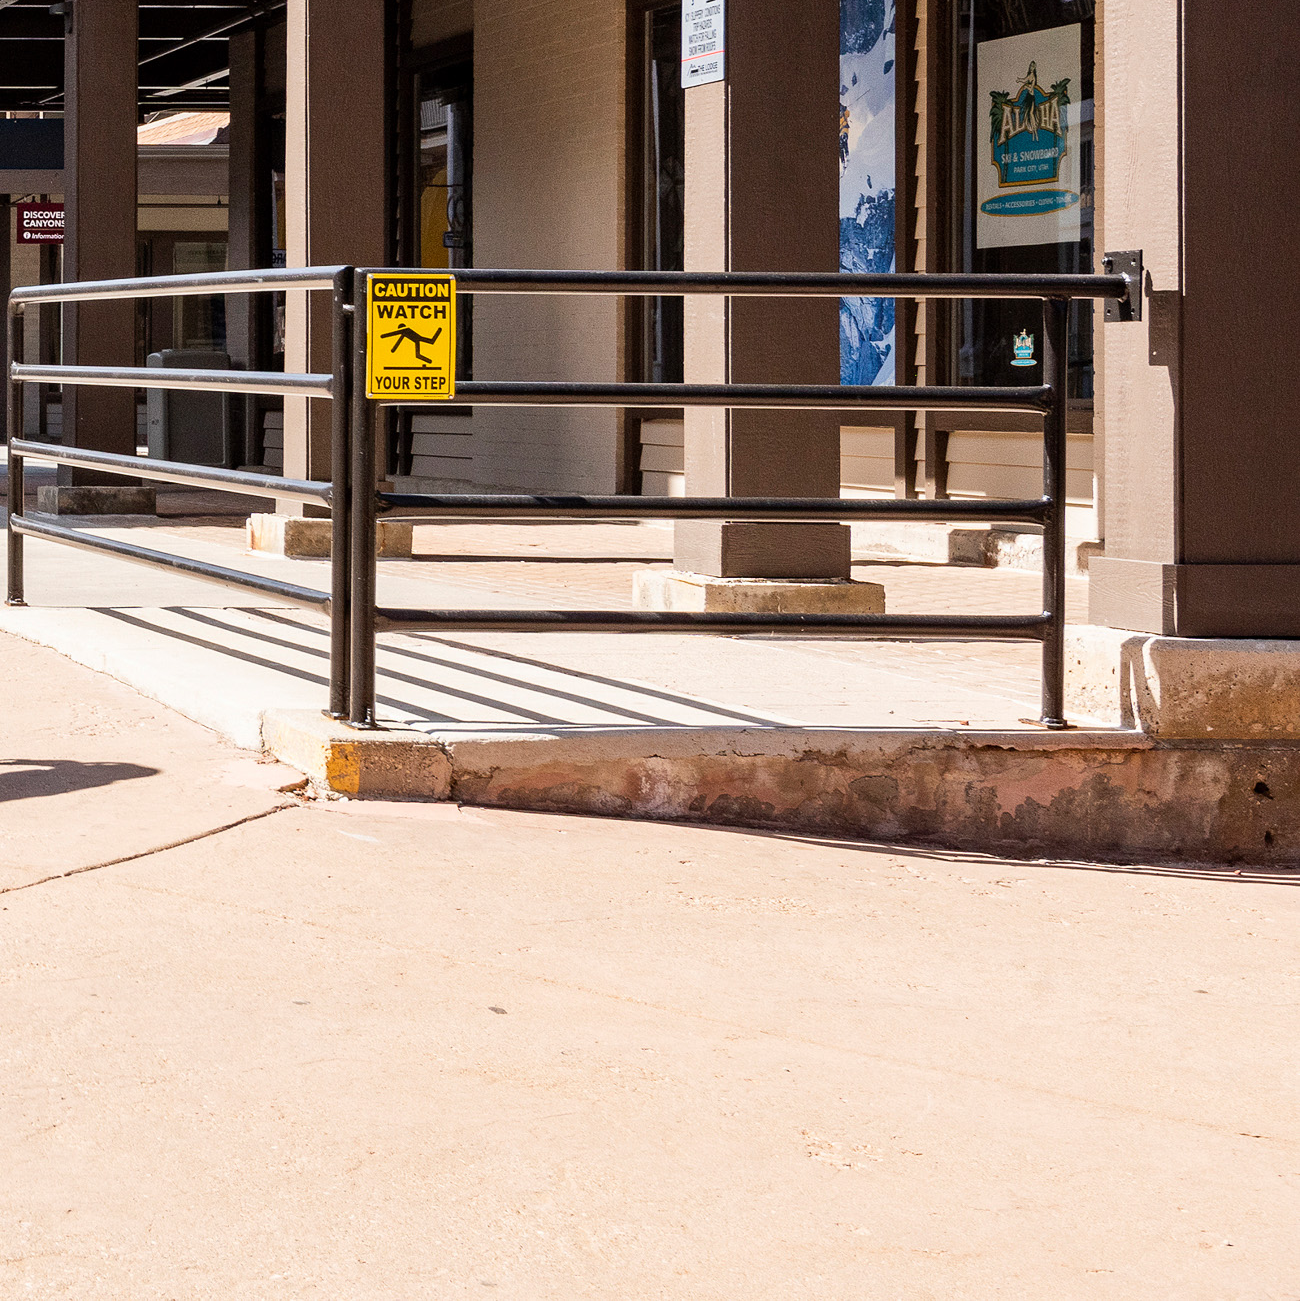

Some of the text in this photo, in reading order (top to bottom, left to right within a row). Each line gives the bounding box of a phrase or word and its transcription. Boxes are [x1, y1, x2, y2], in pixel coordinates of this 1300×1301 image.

[1020, 147, 1059, 162] SNOWBOARD
[374, 283, 449, 298] CAUTION
[377, 305, 447, 319] WATCH
[375, 376, 446, 390] YOUR STEP
